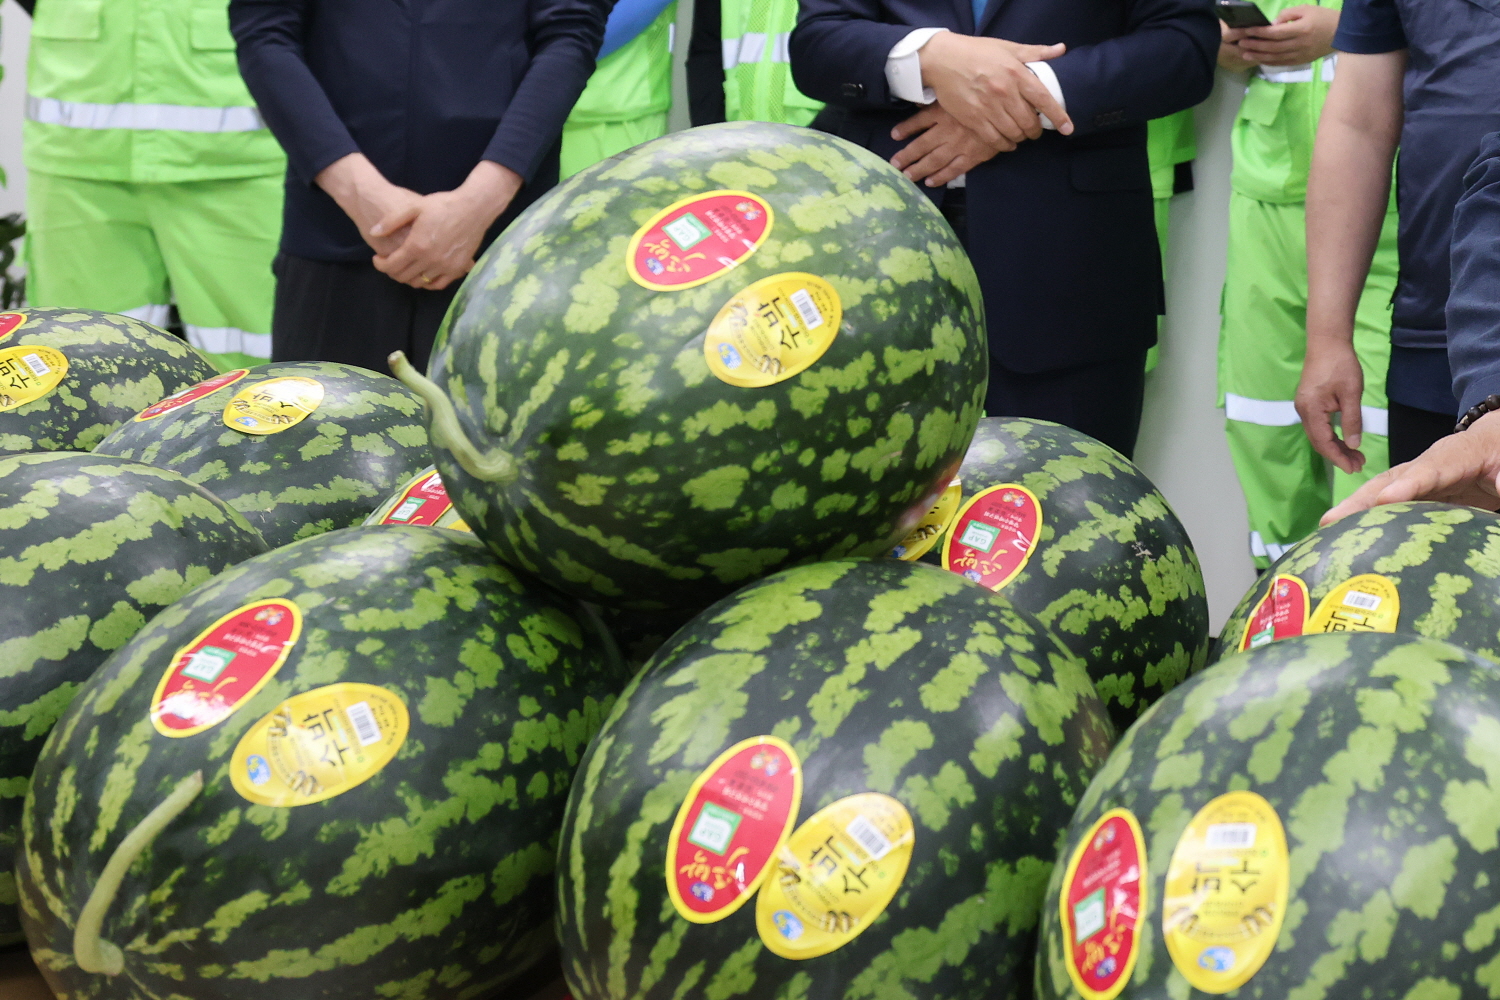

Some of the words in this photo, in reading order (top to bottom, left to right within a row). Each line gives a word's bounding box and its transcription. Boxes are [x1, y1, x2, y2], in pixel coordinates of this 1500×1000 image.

[756, 296, 800, 351] 수박
[968, 535, 987, 545] GAP
[302, 708, 350, 768] 수박
[809, 835, 869, 895] 수박
[1190, 860, 1260, 895] 수박
